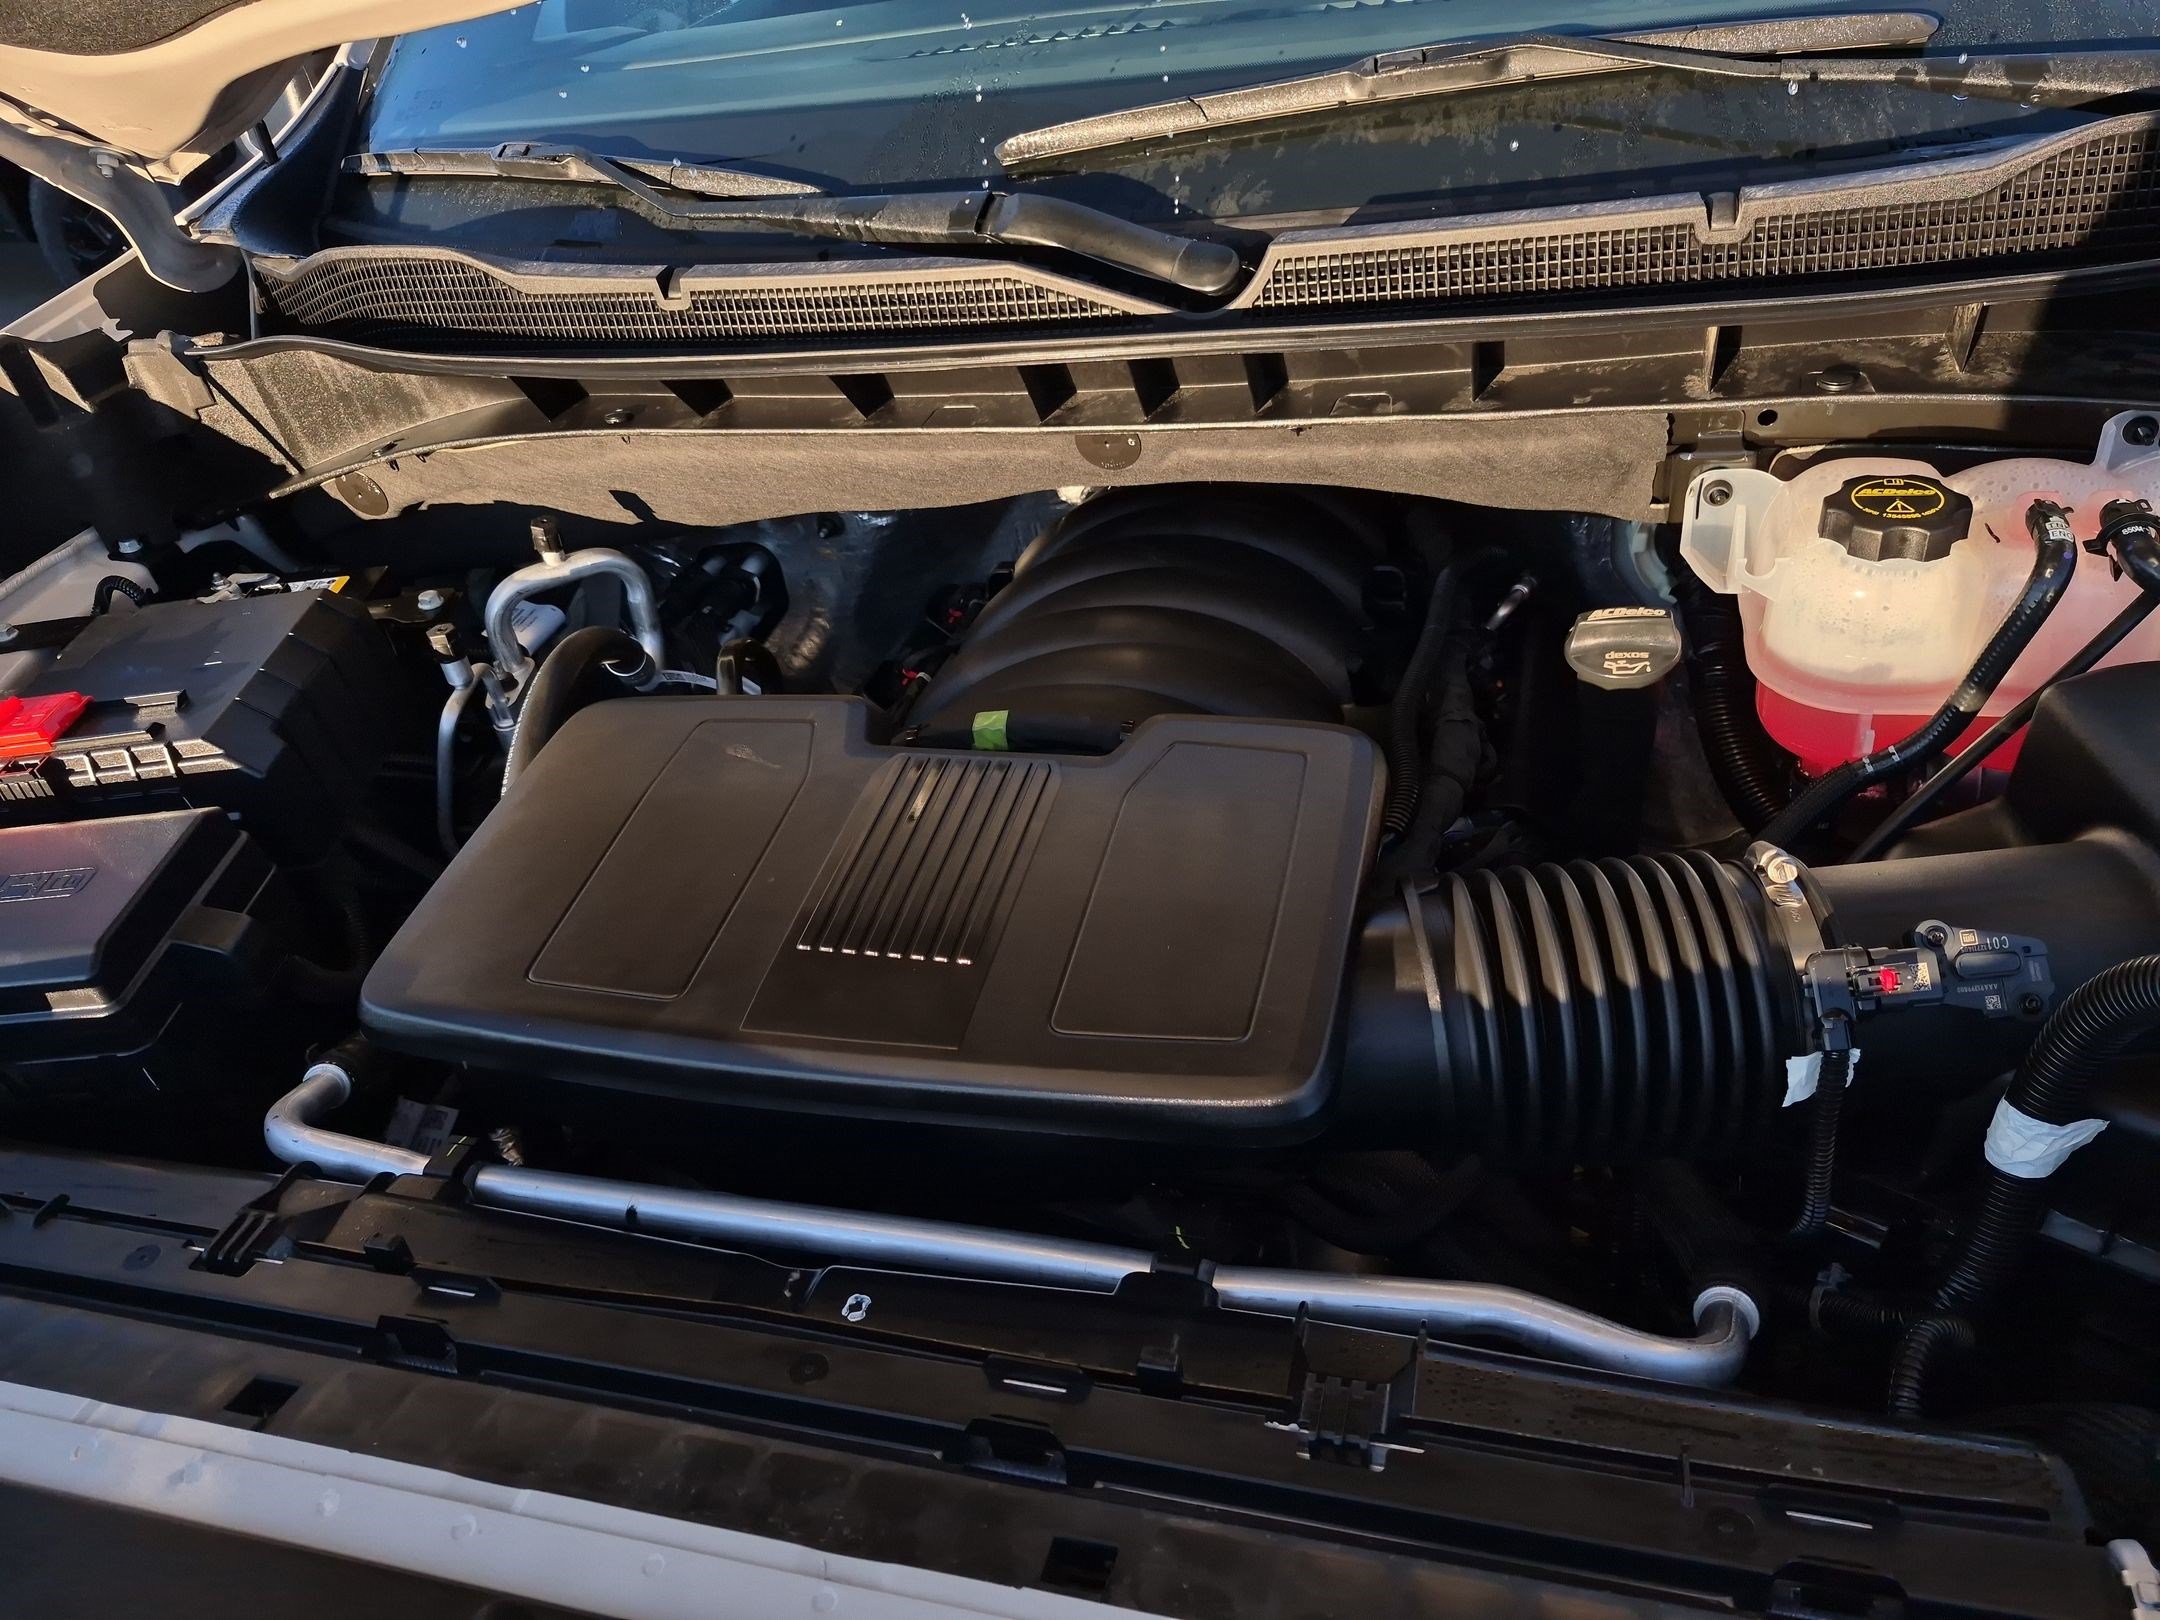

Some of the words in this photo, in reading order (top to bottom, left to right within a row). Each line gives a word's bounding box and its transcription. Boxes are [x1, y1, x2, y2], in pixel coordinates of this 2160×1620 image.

[1856, 488, 1937, 496] ACDelco
[1587, 607, 1667, 620] ACDelco
[1605, 651, 1649, 659] dexos
[1987, 936, 2009, 949] C01
